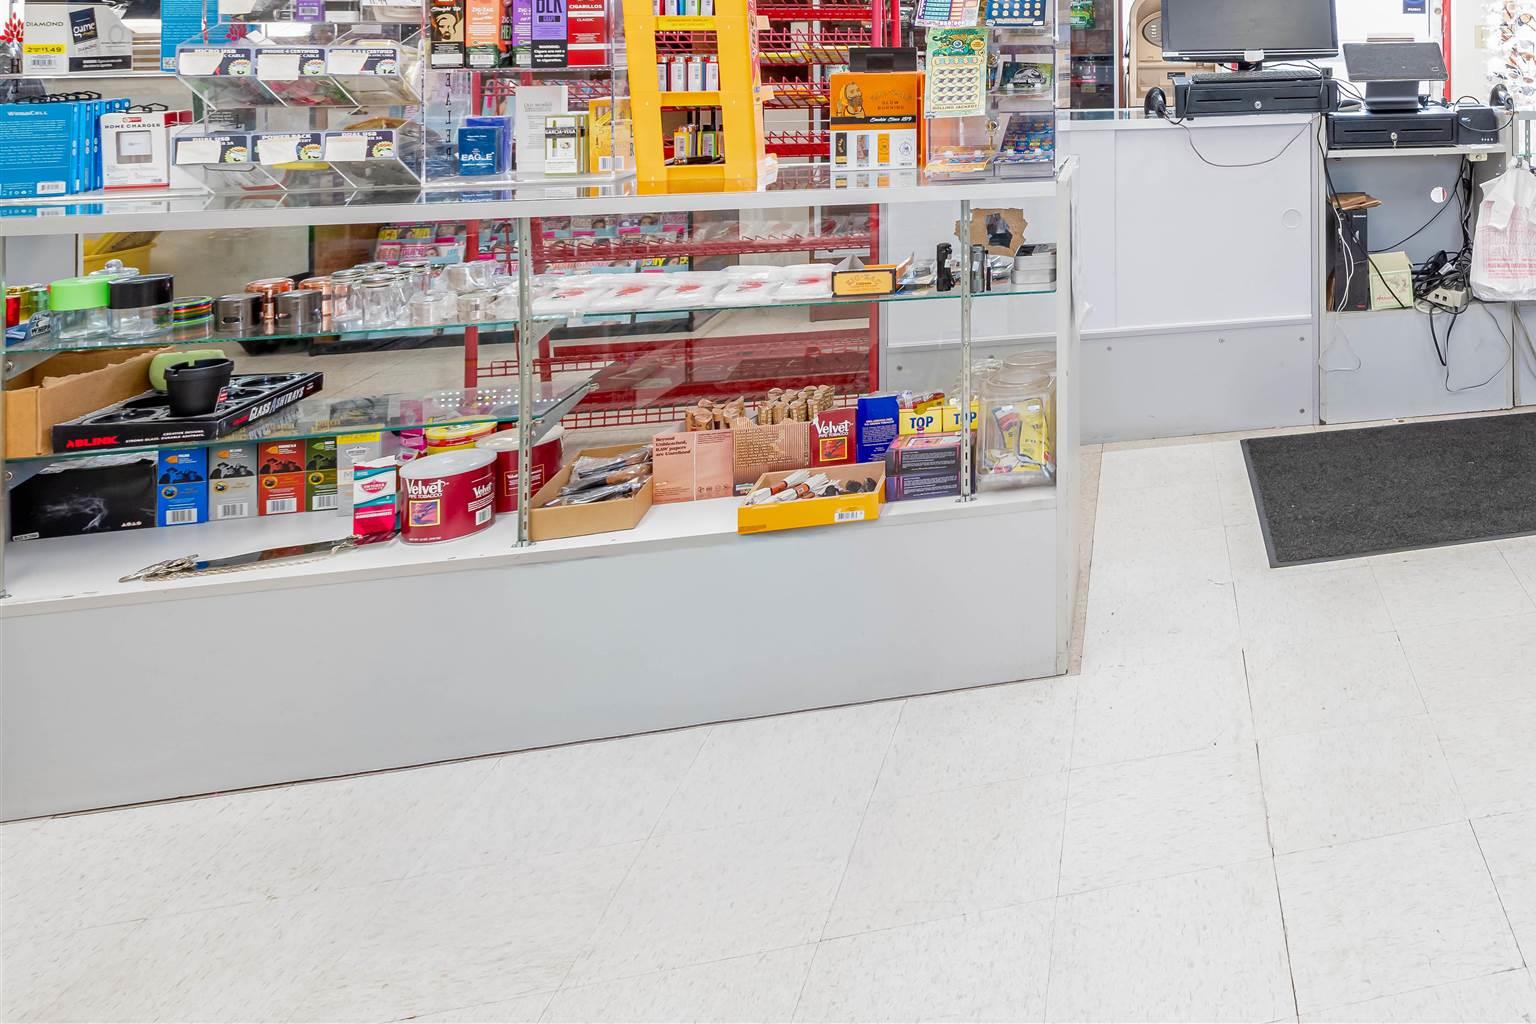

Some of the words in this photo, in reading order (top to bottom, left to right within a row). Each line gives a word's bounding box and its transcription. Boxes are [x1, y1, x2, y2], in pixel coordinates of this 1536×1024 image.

[248, 401, 273, 422] GLASS
[269, 387, 305, 414] ASHTRAYS
[813, 412, 850, 434] Velvet
[909, 416, 934, 429] TOP
[953, 412, 977, 425] TP
[405, 478, 445, 494] Velvet
[473, 482, 494, 498] Velvet
